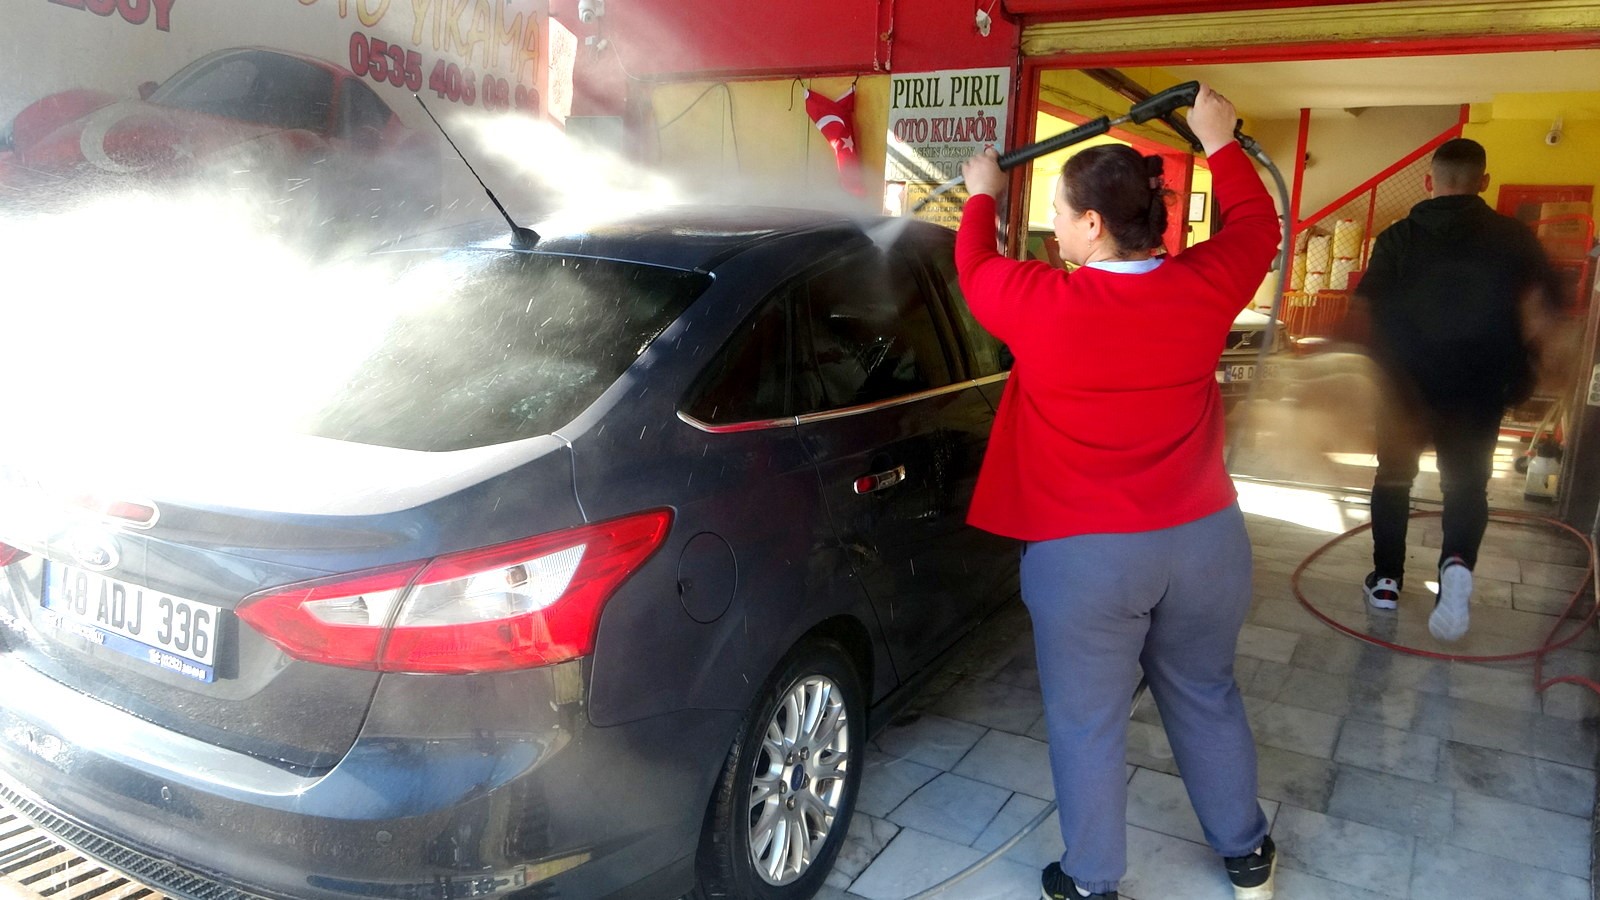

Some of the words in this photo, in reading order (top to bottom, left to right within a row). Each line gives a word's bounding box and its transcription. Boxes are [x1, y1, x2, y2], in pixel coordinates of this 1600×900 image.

[350, 32, 423, 92] 0535
[429, 59, 477, 106] 406
[892, 78, 944, 109] PIRIL
[949, 75, 1004, 107] PIRIL
[894, 118, 929, 143] OTO
[930, 110, 998, 142] KUAFÖR
[1231, 367, 1244, 379] 48
[61, 567, 88, 615] 48
[97, 578, 143, 636] ADJ
[157, 597, 210, 658] 336
